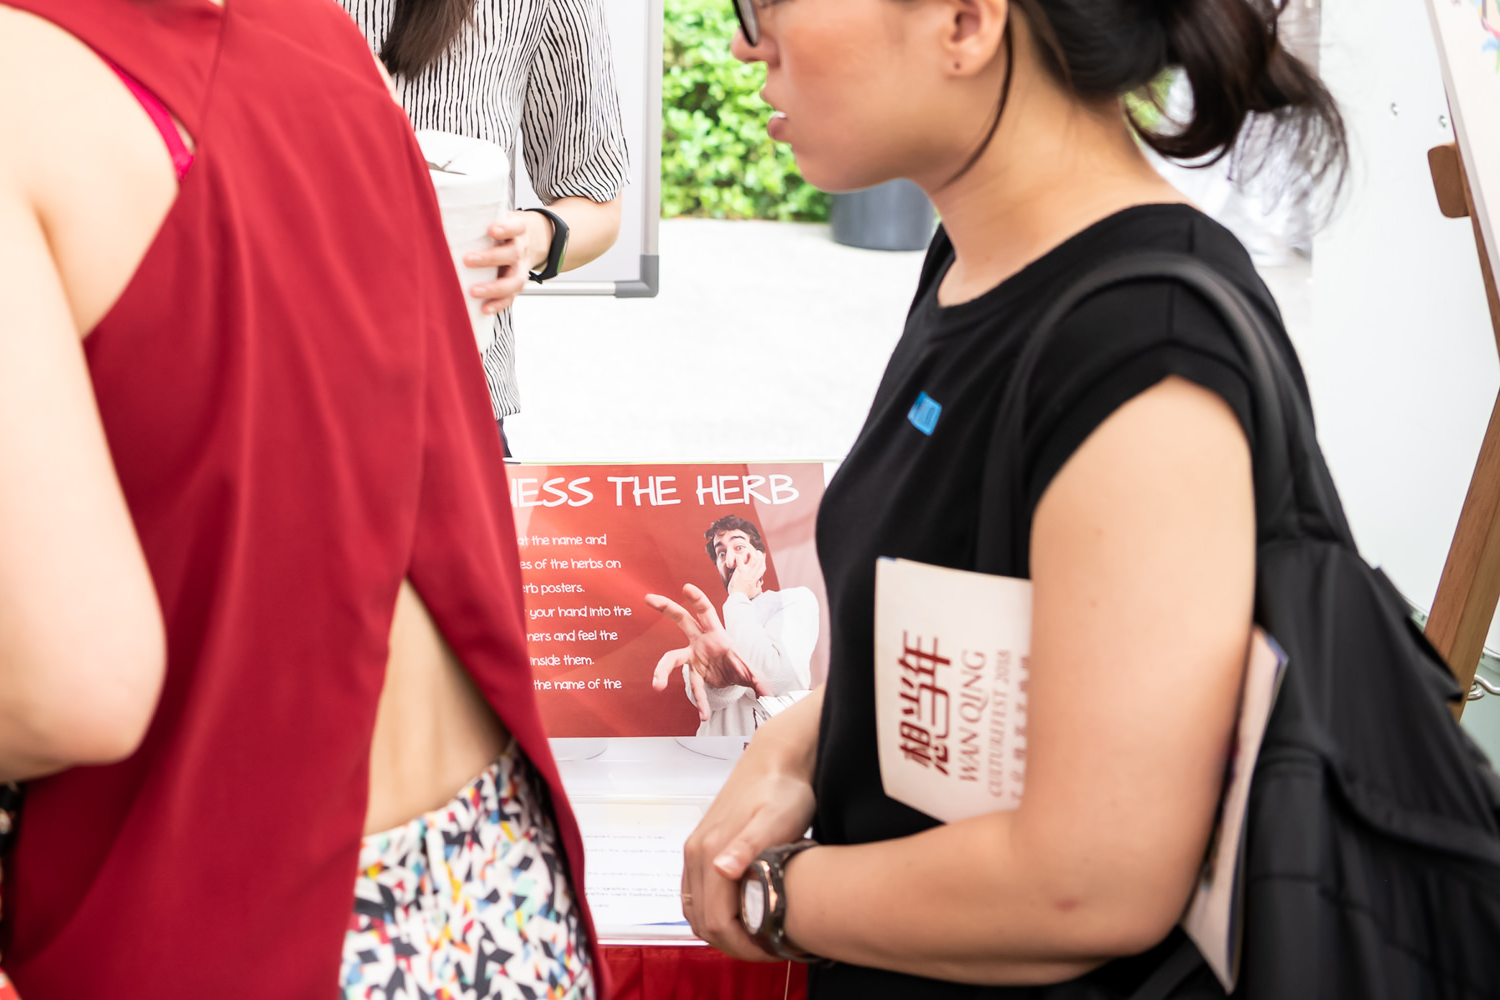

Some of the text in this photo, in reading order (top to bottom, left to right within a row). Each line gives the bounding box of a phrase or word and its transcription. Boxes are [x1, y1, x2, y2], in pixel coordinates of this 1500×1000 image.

[512, 474, 799, 507] ESS THE HERB
[532, 536, 549, 545] the
[552, 536, 582, 545] name
[585, 534, 607, 545] and
[520, 558, 621, 569] es of the herbs on
[523, 583, 585, 595] rb posters.
[530, 606, 632, 619] your hand into the
[527, 630, 618, 641] ners and feel the
[563, 655, 594, 665] them.
[534, 679, 622, 690] the name of the
[899, 630, 951, 776] 想当年
[958, 650, 988, 781] WAN QING
